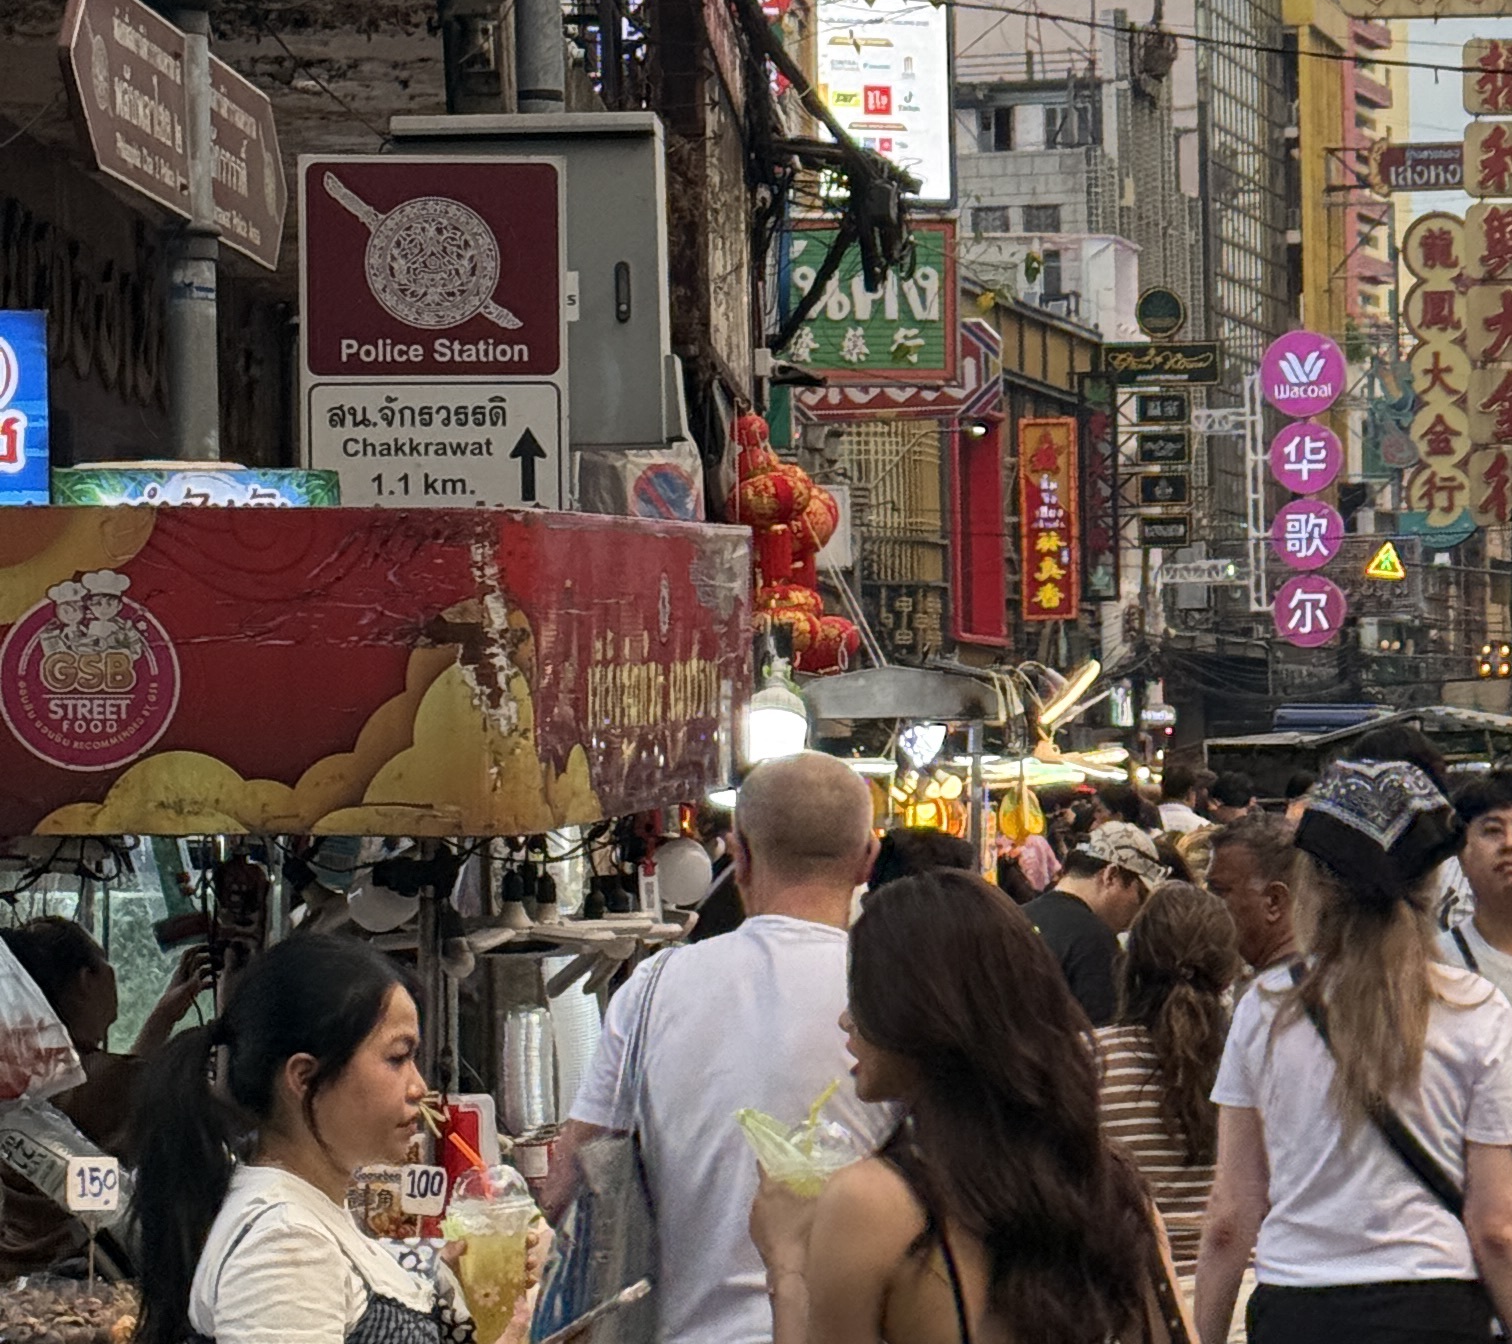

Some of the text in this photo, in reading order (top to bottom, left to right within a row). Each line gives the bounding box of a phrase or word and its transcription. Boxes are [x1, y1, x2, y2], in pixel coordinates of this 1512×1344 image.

[340, 338, 529, 362] Police Station
[1273, 383, 1333, 399] Wacoal
[326, 394, 508, 429] สน.จักรวรรดิ
[341, 437, 494, 458] Chakkrawat
[370, 471, 477, 496] 1.1 km.
[1283, 435, 1332, 635] 华歌尔
[41, 650, 137, 692] GSB
[49, 698, 131, 721] STREET
[62, 719, 118, 734] FOOD
[405, 1168, 444, 1199] 100
